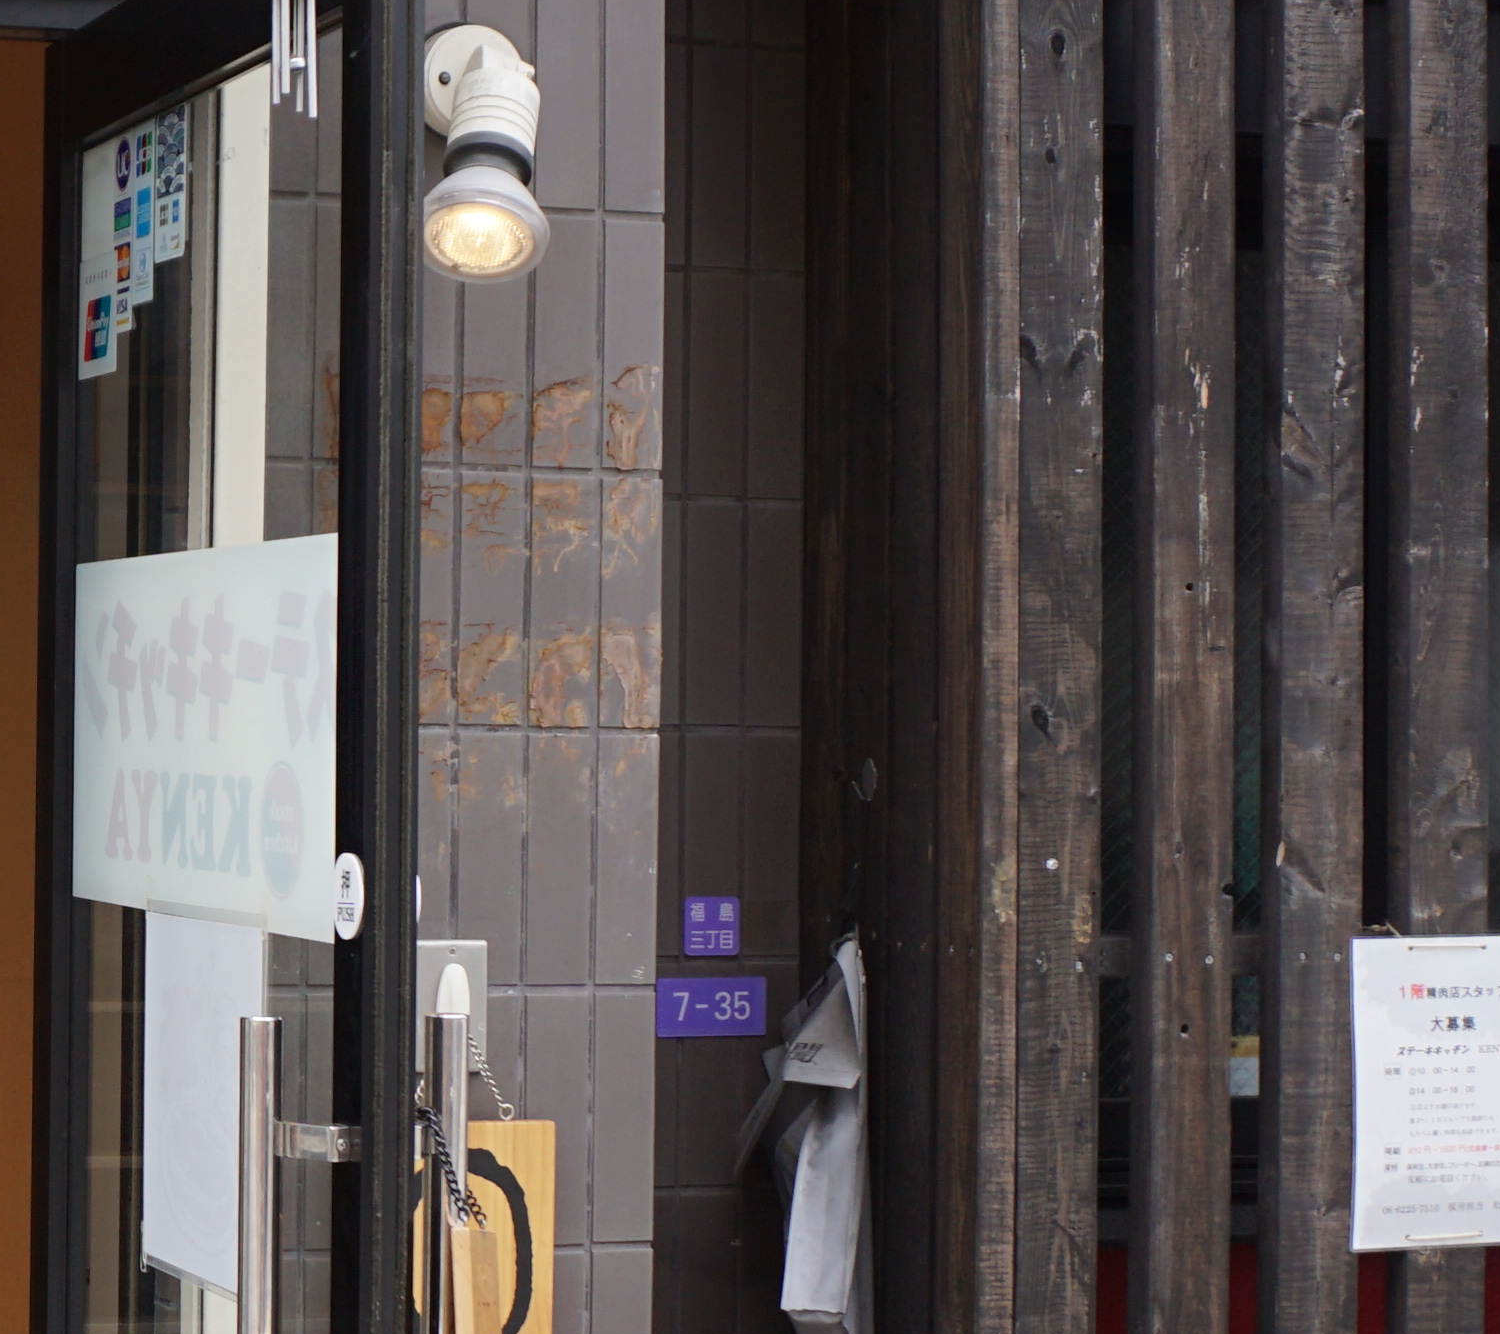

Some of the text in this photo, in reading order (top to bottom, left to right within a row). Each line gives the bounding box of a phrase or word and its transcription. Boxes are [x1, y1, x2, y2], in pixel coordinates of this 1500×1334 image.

[689, 929, 734, 949] 三丁目
[672, 990, 750, 1022] 7-35
[1430, 1015, 1477, 1032] 大募集
[1397, 1044, 1470, 1056] ステーキキッチン
